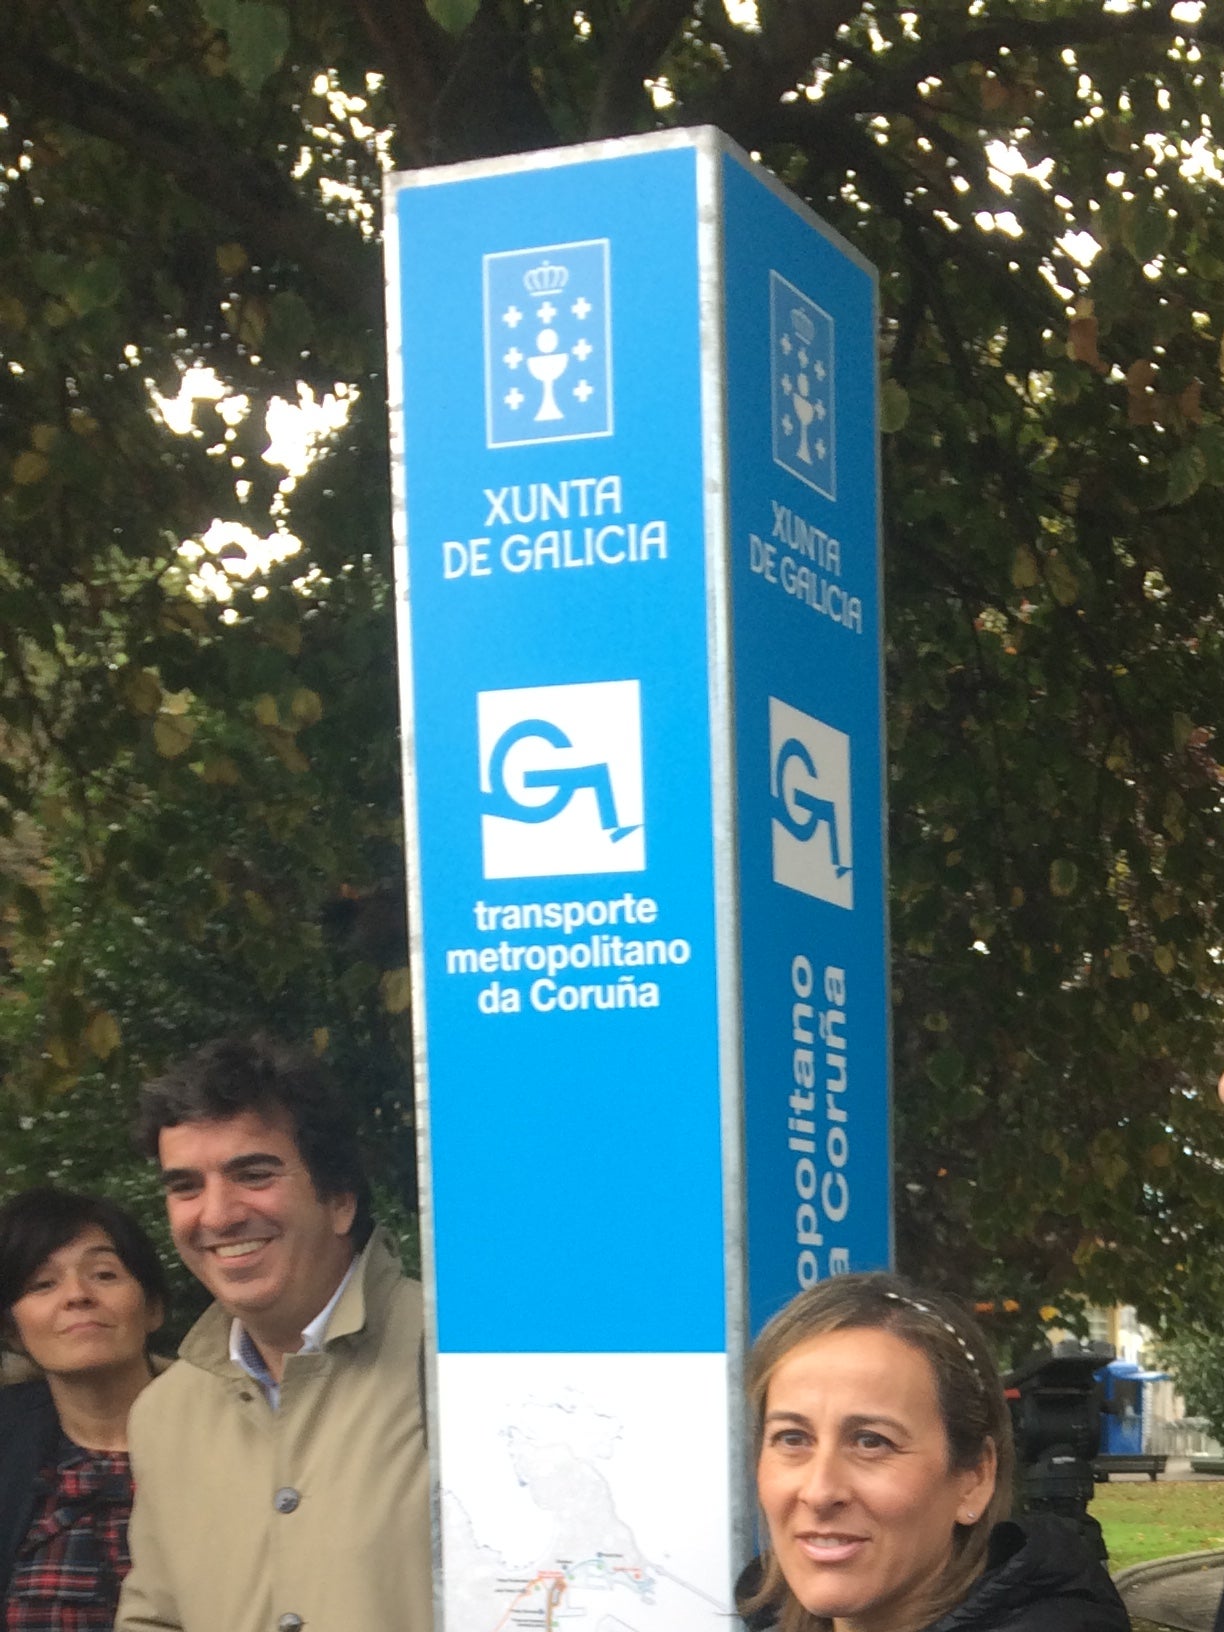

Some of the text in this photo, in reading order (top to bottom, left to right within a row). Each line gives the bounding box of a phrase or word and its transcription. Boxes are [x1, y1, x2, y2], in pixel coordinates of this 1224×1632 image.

[484, 475, 622, 527] XUNTA
[442, 520, 668, 580] DE GALICIA
[772, 500, 840, 577] XUNTA
[749, 533, 862, 634] DE GALICIA
[473, 892, 658, 934] transporte
[446, 934, 691, 977] metropolitano
[478, 975, 660, 1014] da Coruña
[789, 955, 824, 1291] opolitano
[819, 966, 849, 1222] Coruña
